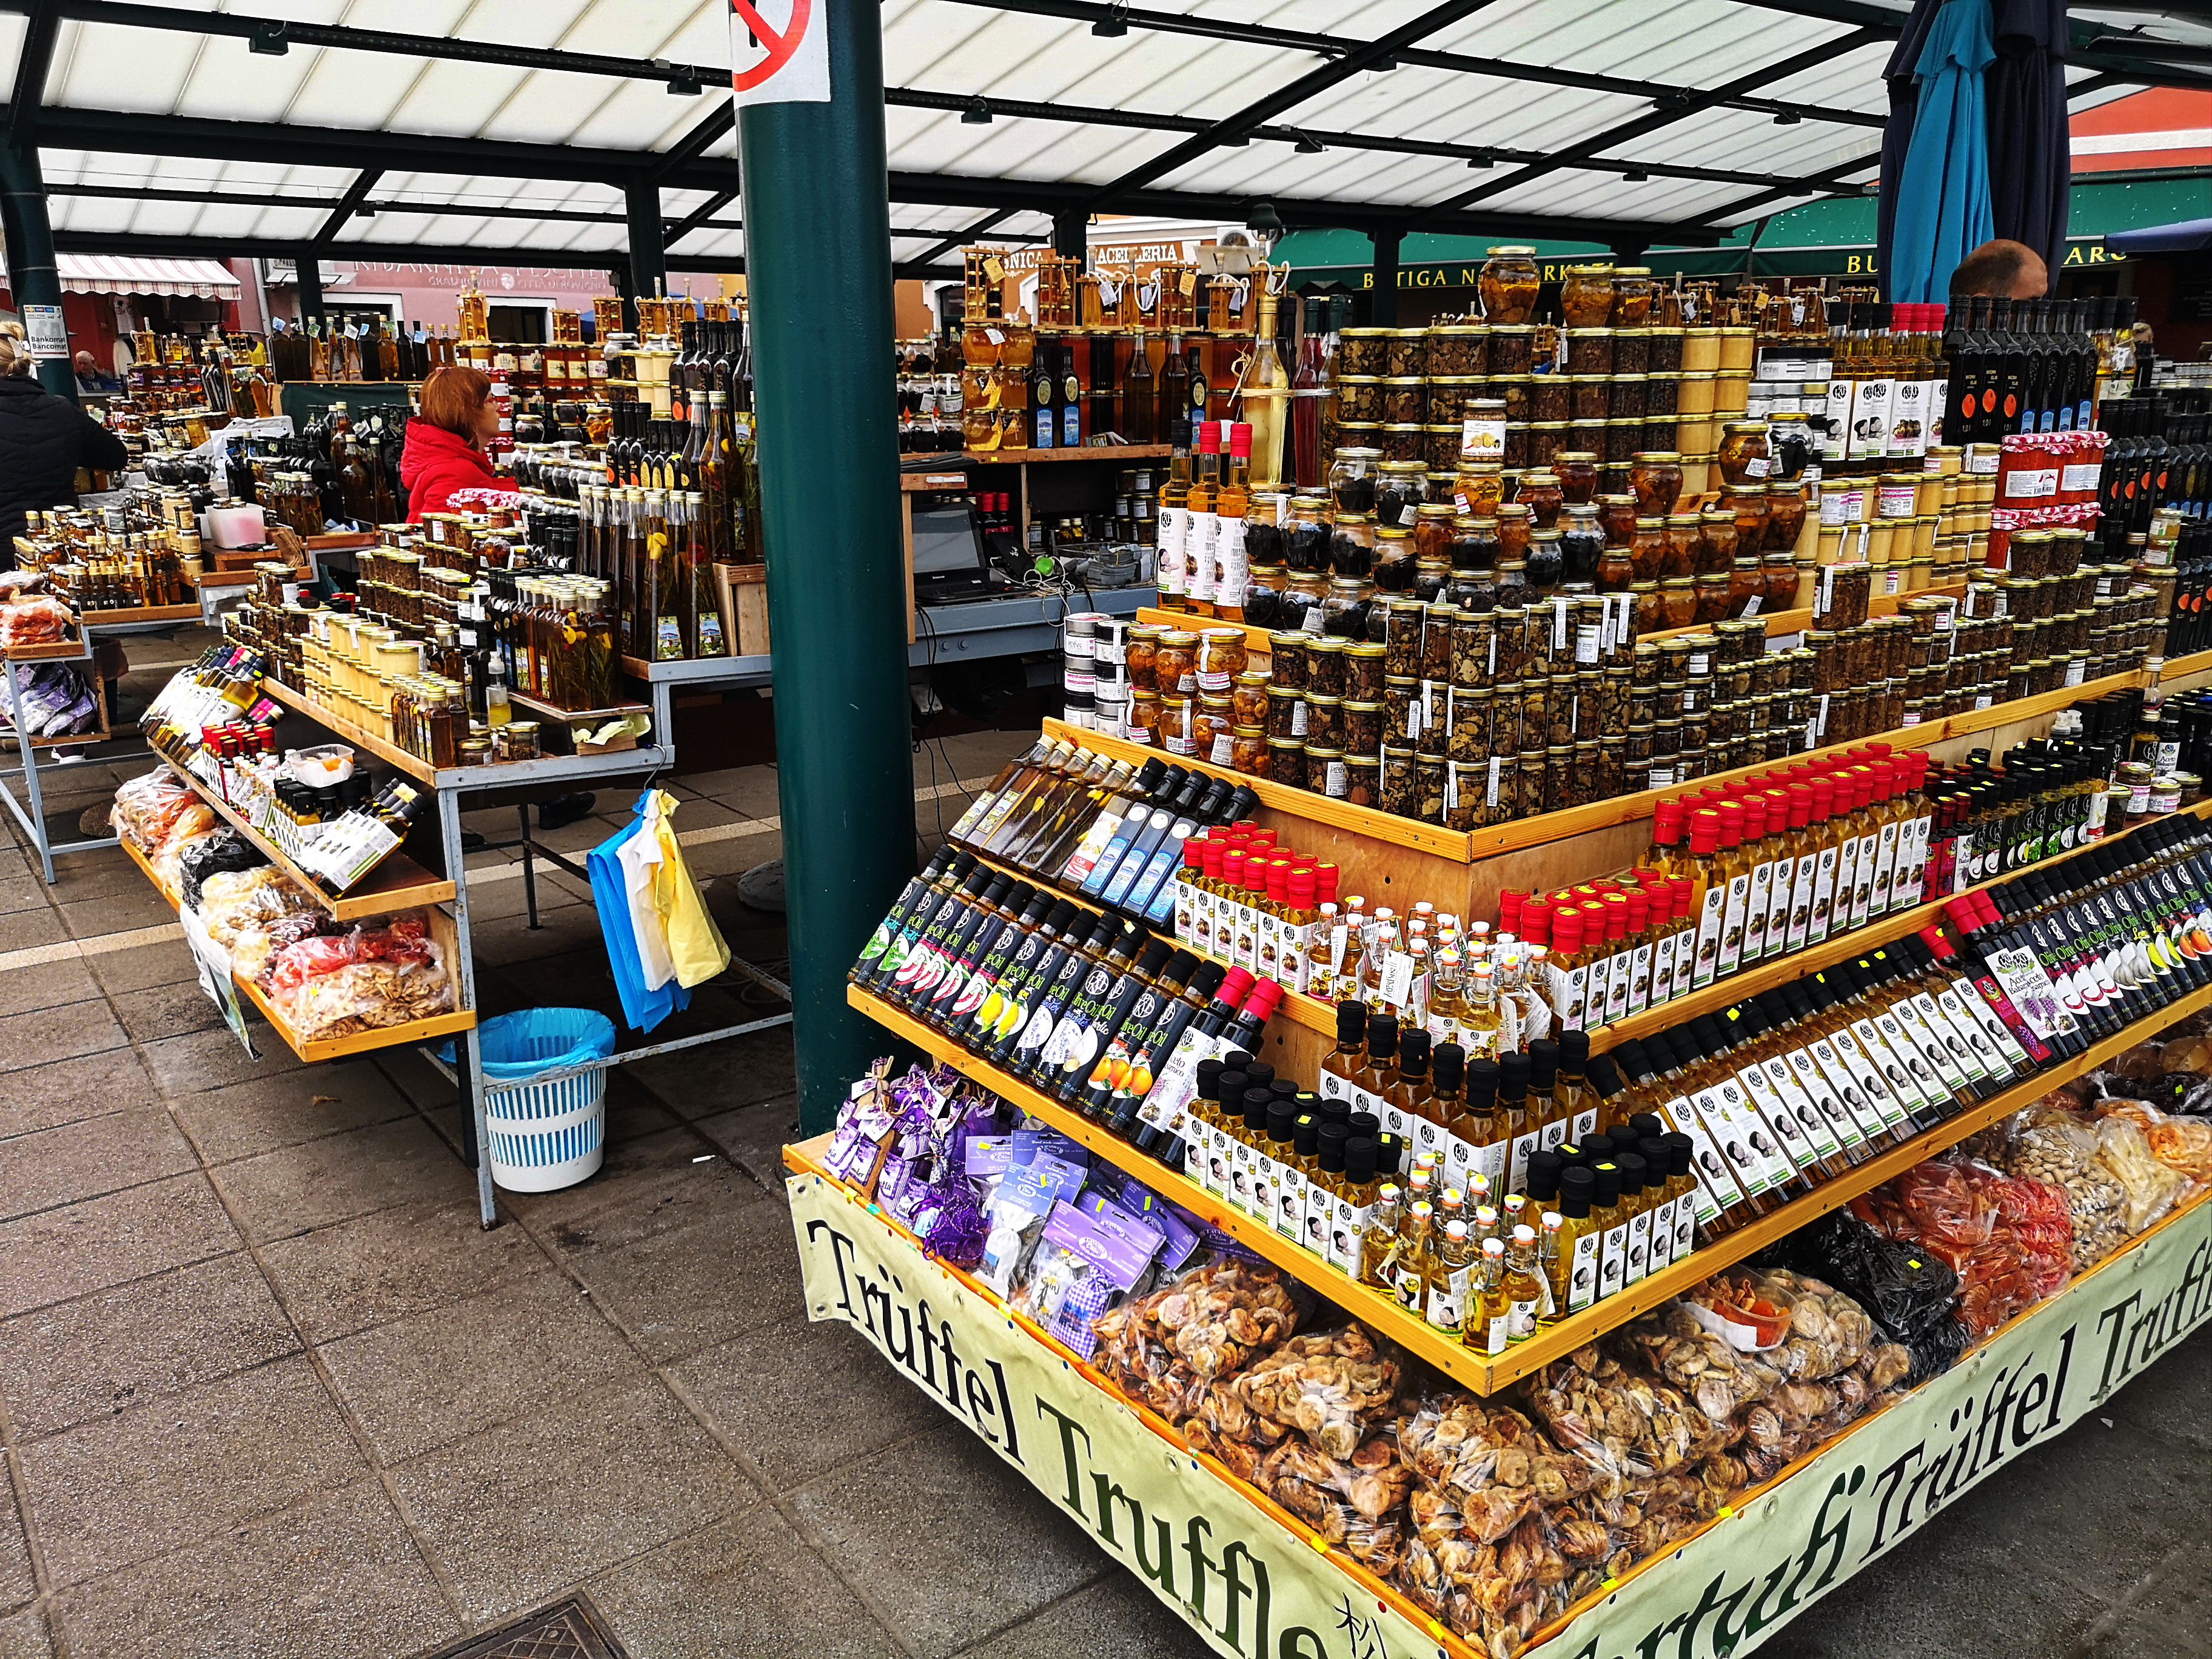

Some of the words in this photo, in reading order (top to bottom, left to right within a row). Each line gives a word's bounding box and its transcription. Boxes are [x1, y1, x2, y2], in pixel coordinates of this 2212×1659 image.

[1363, 269, 1447, 289] BTIGA
[806, 1219, 1025, 1467] Trüffel
[1858, 1322, 2077, 1564] Trüffel
